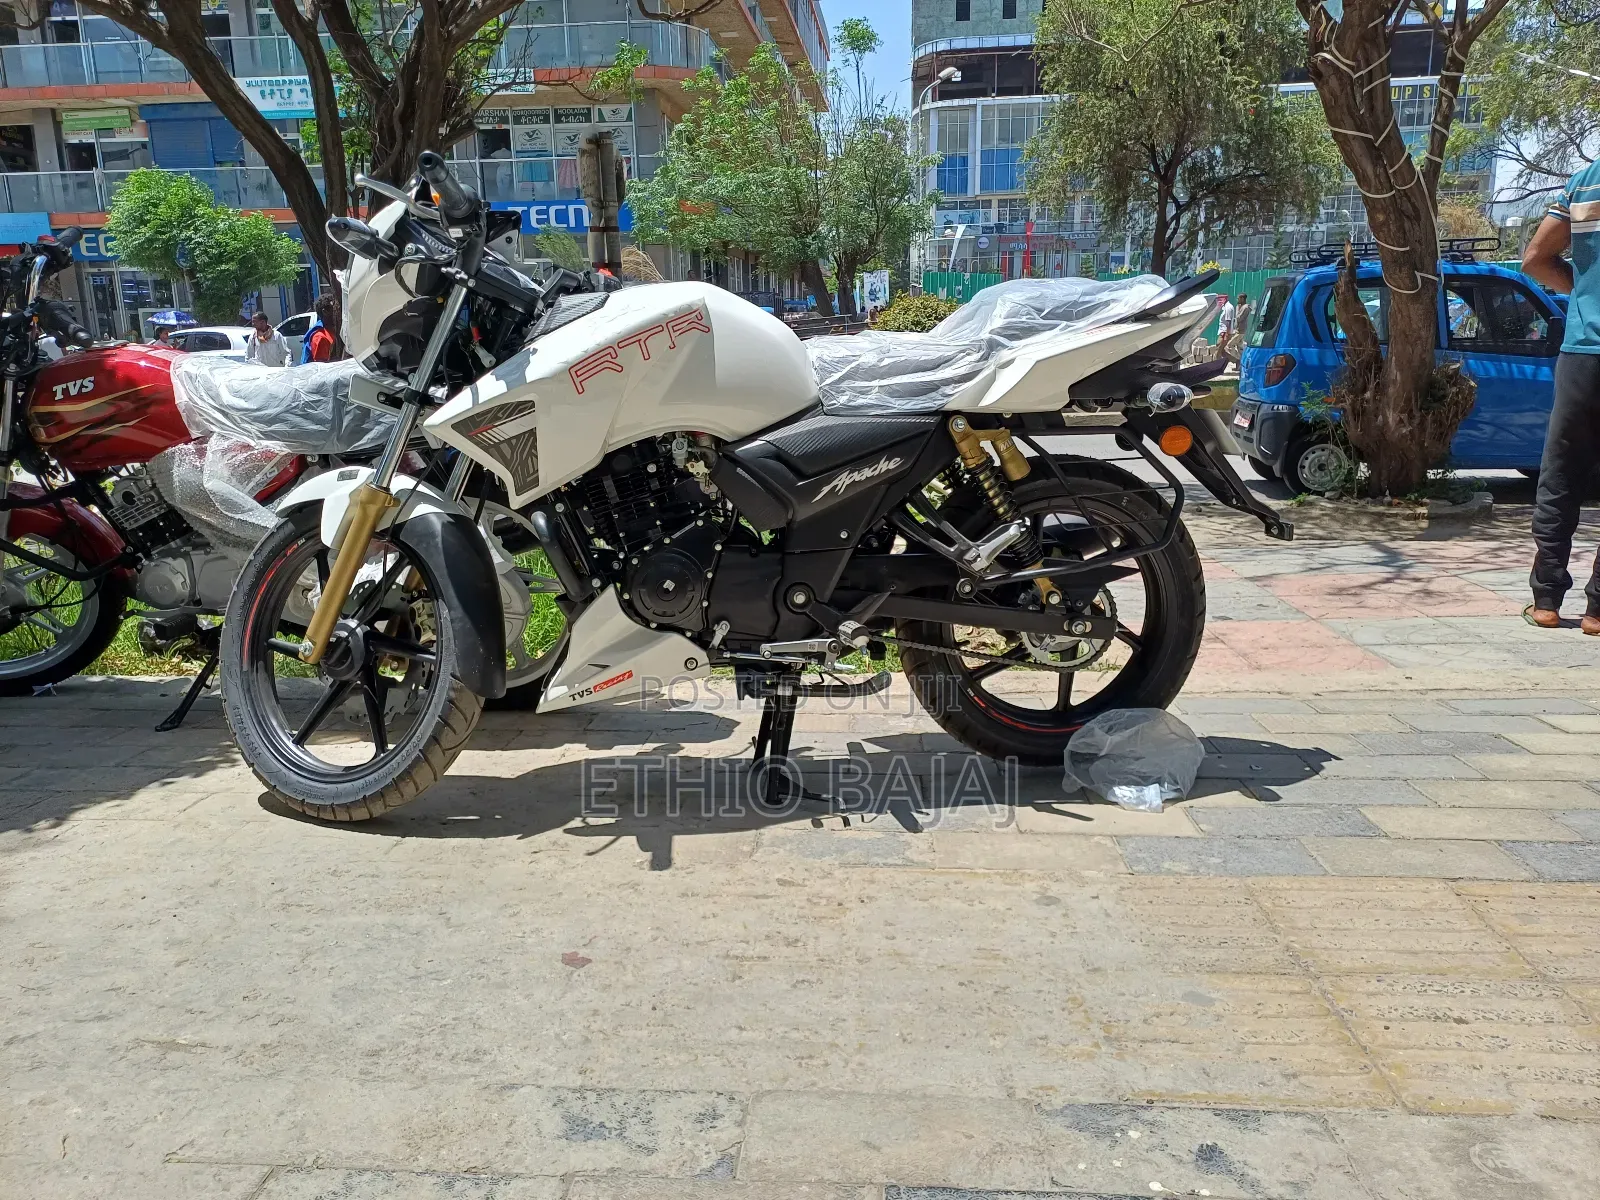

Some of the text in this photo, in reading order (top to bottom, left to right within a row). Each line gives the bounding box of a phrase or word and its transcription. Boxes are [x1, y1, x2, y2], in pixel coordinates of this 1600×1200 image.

[507, 204, 590, 229] TECN
[568, 308, 711, 395] RTR
[52, 376, 95, 401] TVS
[811, 454, 905, 504] Apache
[569, 671, 633, 702] TVS Racing
